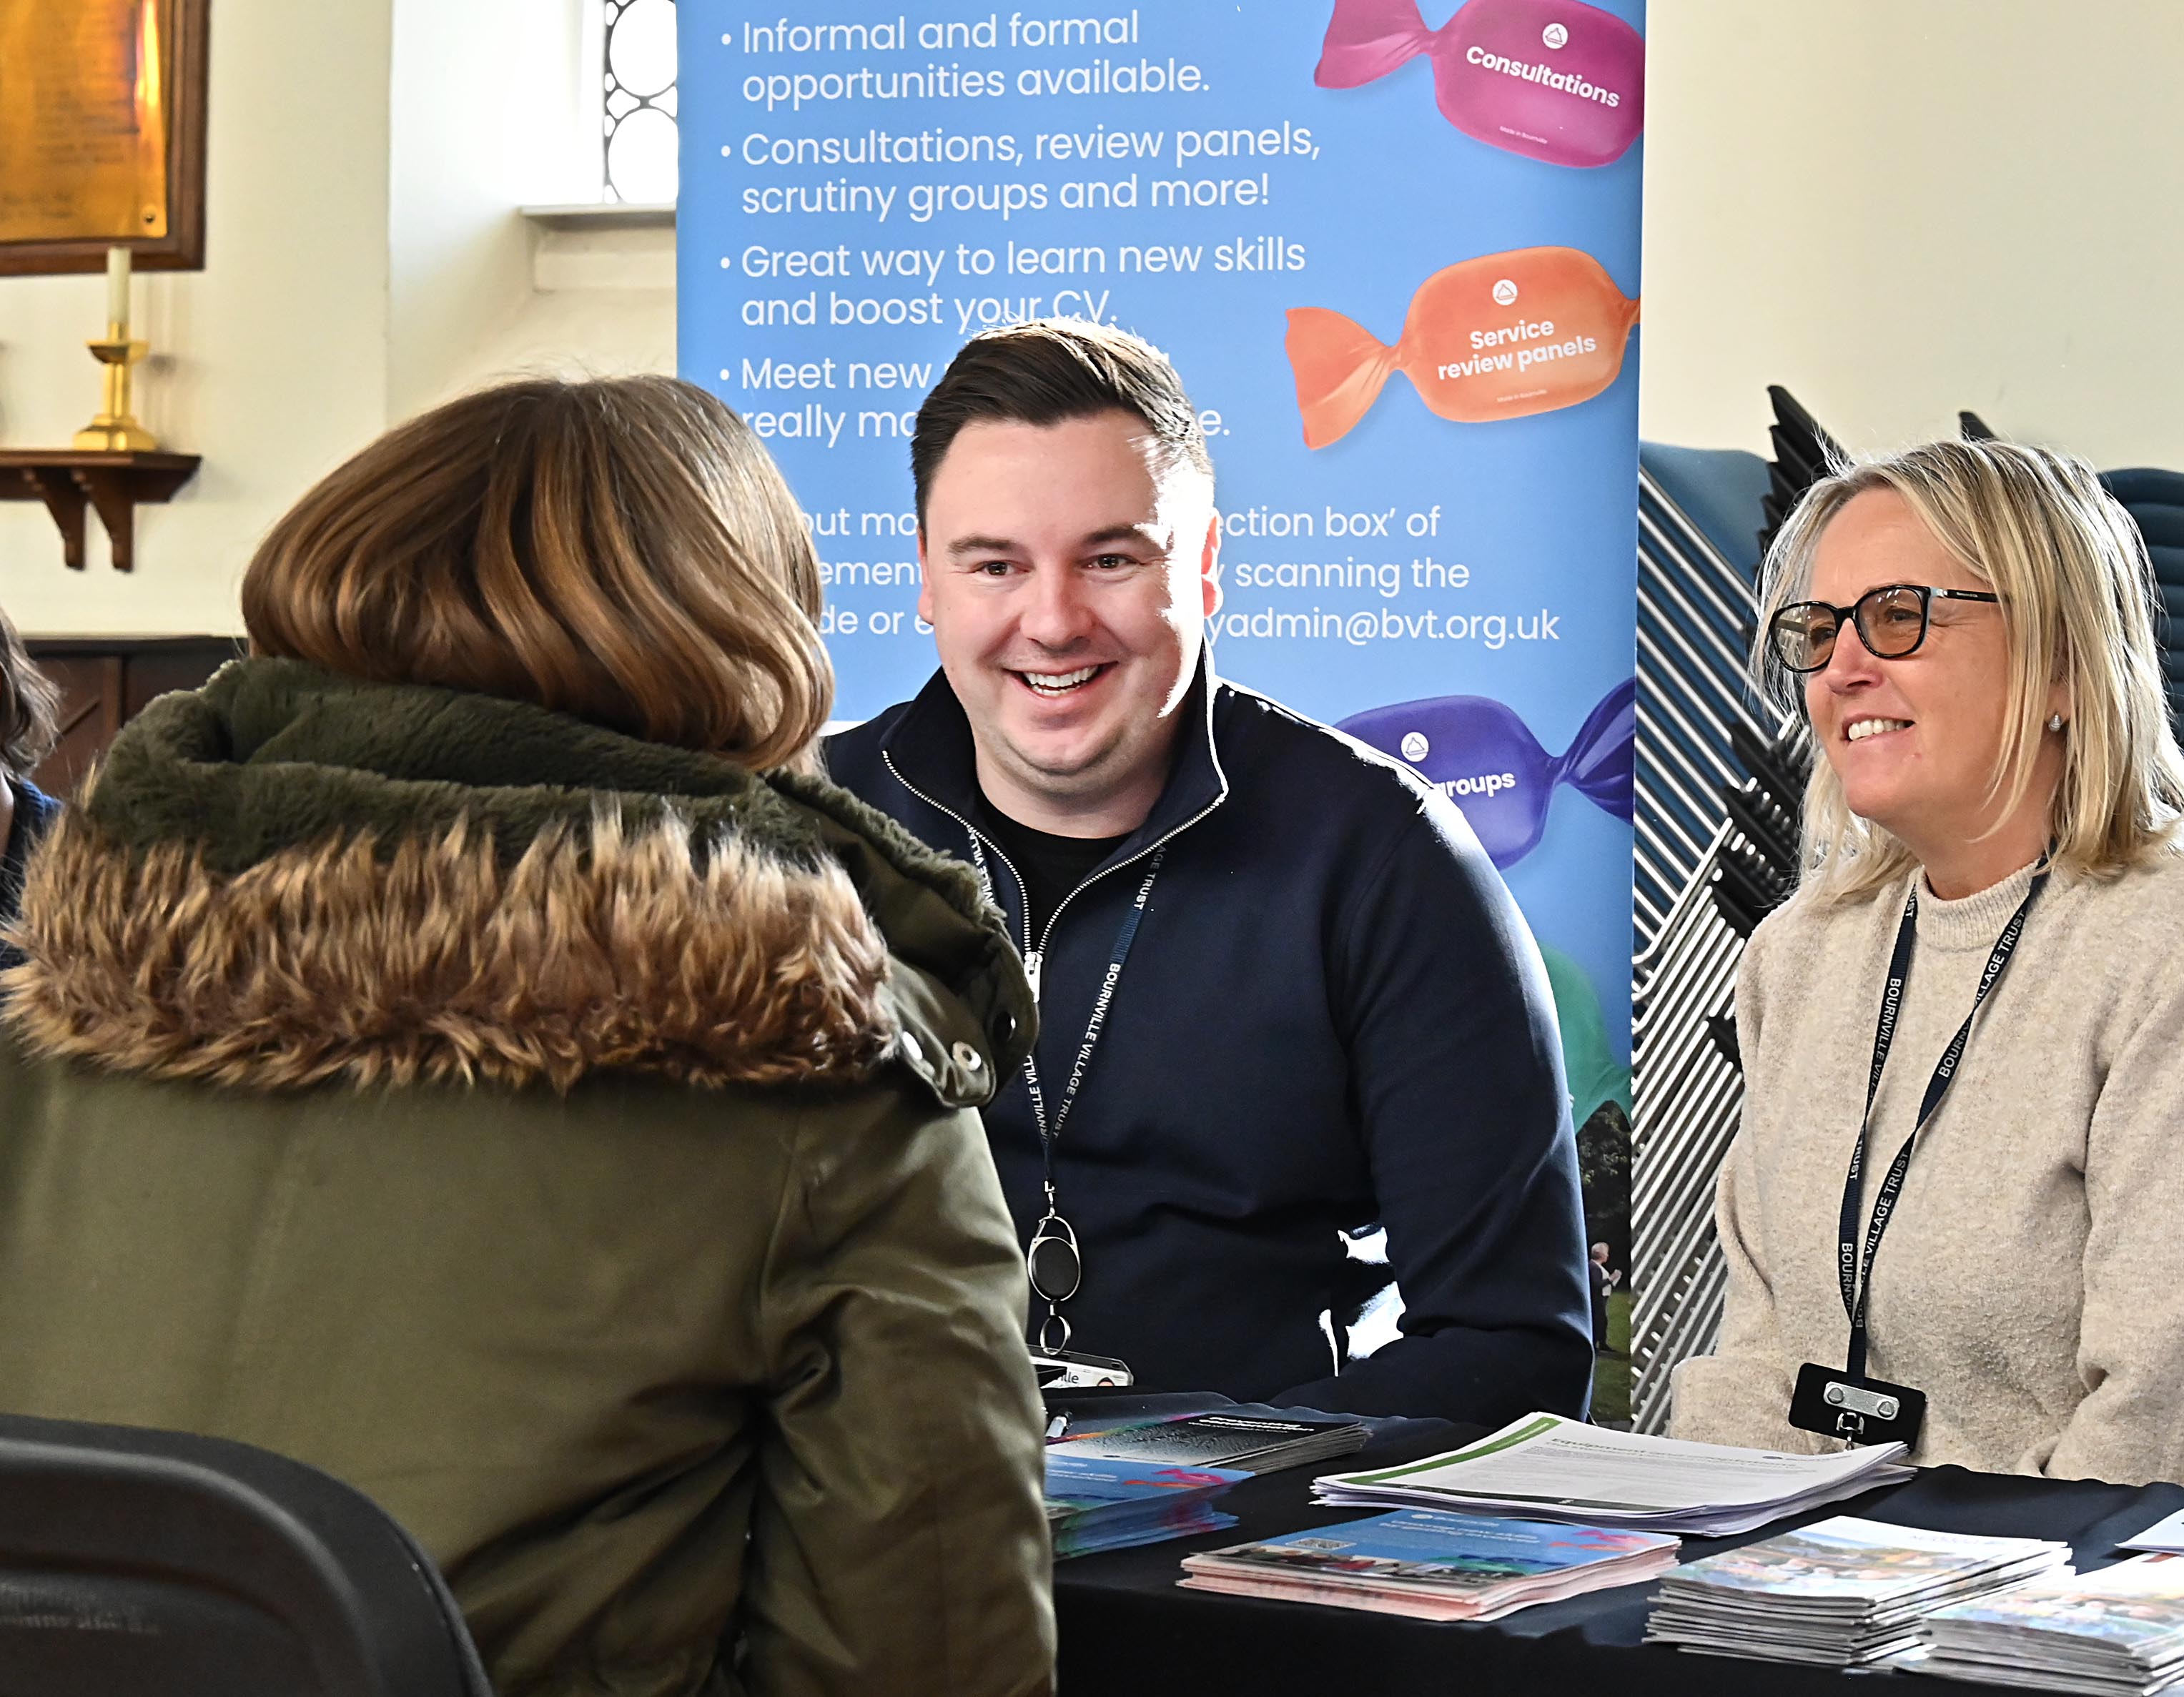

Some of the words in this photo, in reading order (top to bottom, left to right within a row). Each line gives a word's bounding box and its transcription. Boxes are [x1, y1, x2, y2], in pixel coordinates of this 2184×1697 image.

[743, 16, 905, 54] Informal
[919, 14, 997, 49] and
[1009, 9, 1138, 47] formal
[743, 62, 1005, 112] opportunities
[1017, 57, 1210, 97] available.
[1466, 45, 1621, 109] Consultations
[743, 128, 1023, 167] Consultations,
[1035, 124, 1164, 161] review
[1176, 120, 1320, 168] panels,
[742, 177, 896, 223] scrutiny
[908, 182, 1048, 222] groups
[1059, 173, 1137, 209] and
[1151, 172, 1269, 207] more!
[742, 245, 850, 278] Great
[861, 250, 945, 287] way
[956, 244, 996, 276] to
[1007, 240, 1106, 274] learn
[1119, 246, 1203, 272] new
[1215, 235, 1306, 272] skills
[741, 291, 817, 326] and
[829, 291, 944, 325] boost
[954, 297, 1042, 335] your
[1052, 290, 1117, 324] CV.
[1437, 348, 1513, 380] review
[1517, 335, 1597, 372] panels
[1469, 319, 1555, 352] Service
[741, 357, 836, 390] Meet
[848, 362, 933, 390] new
[742, 403, 846, 449] really
[1218, 505, 1314, 537] ction
[1405, 505, 1442, 538] of
[1234, 555, 1401, 598] scanning
[1411, 557, 1471, 589] the
[869, 611, 904, 635] or
[1207, 606, 1561, 649] yadmin@bvt.org.uk
[1433, 772, 1516, 798] roups
[1133, 873, 1157, 910] TRUST
[1997, 911, 2025, 953] TRUST
[1084, 962, 1121, 1042] BOURNVILLE
[1875, 977, 1902, 1061] BOURNVILLE
[1066, 1043, 1094, 1096] VILLAGE
[1052, 1099, 1073, 1139] TRUST
[1864, 1197, 1892, 1255] VILLAGE
[1883, 1152, 1909, 1194] TRUST
